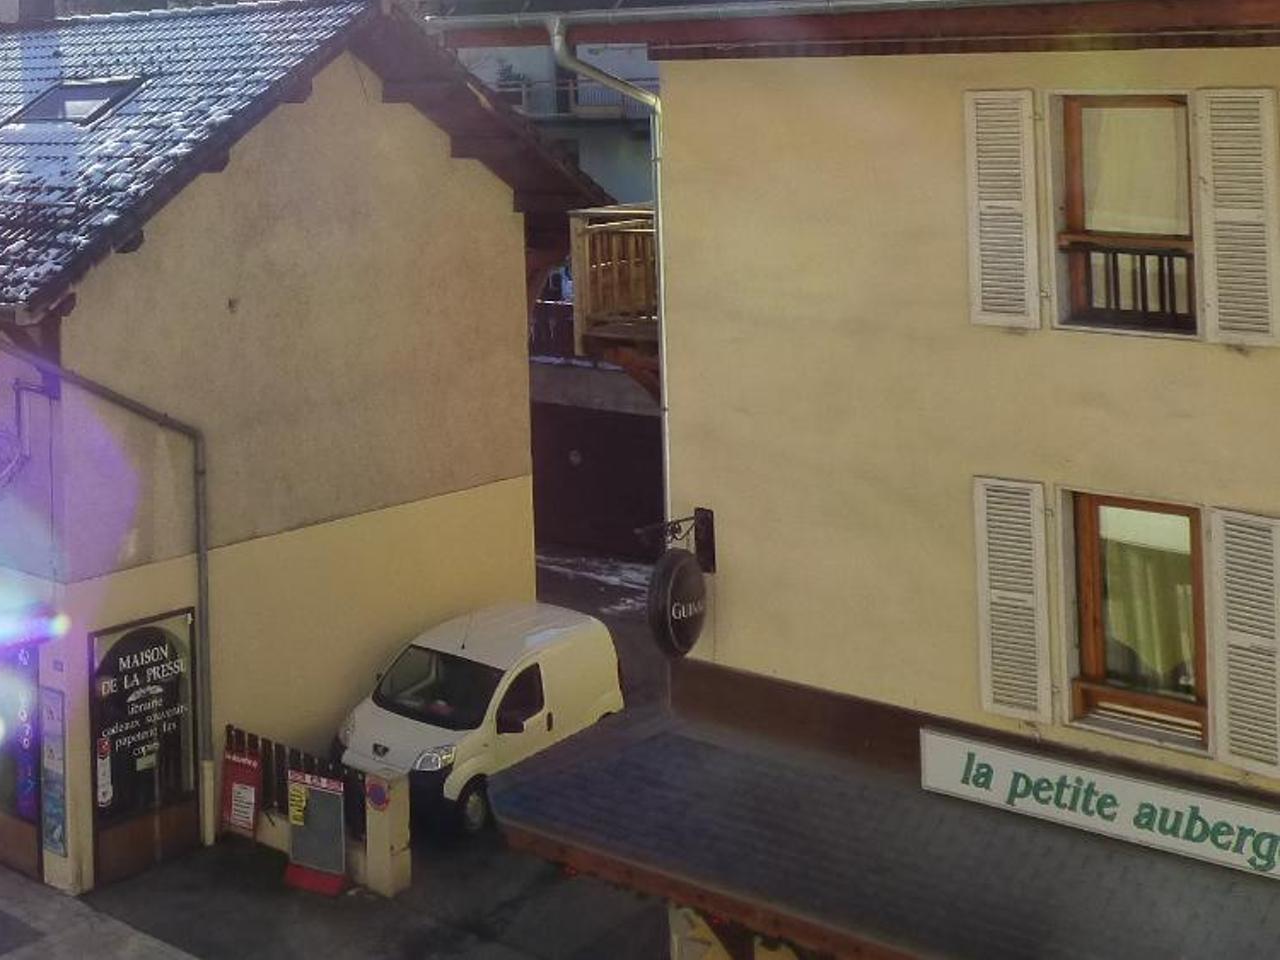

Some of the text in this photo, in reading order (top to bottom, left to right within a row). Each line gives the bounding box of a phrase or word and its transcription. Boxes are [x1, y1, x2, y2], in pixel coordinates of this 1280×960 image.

[119, 644, 169, 671] MAISON
[102, 679, 118, 696] DE
[124, 673, 139, 689] LA
[960, 752, 1280, 871] la petite auberg
